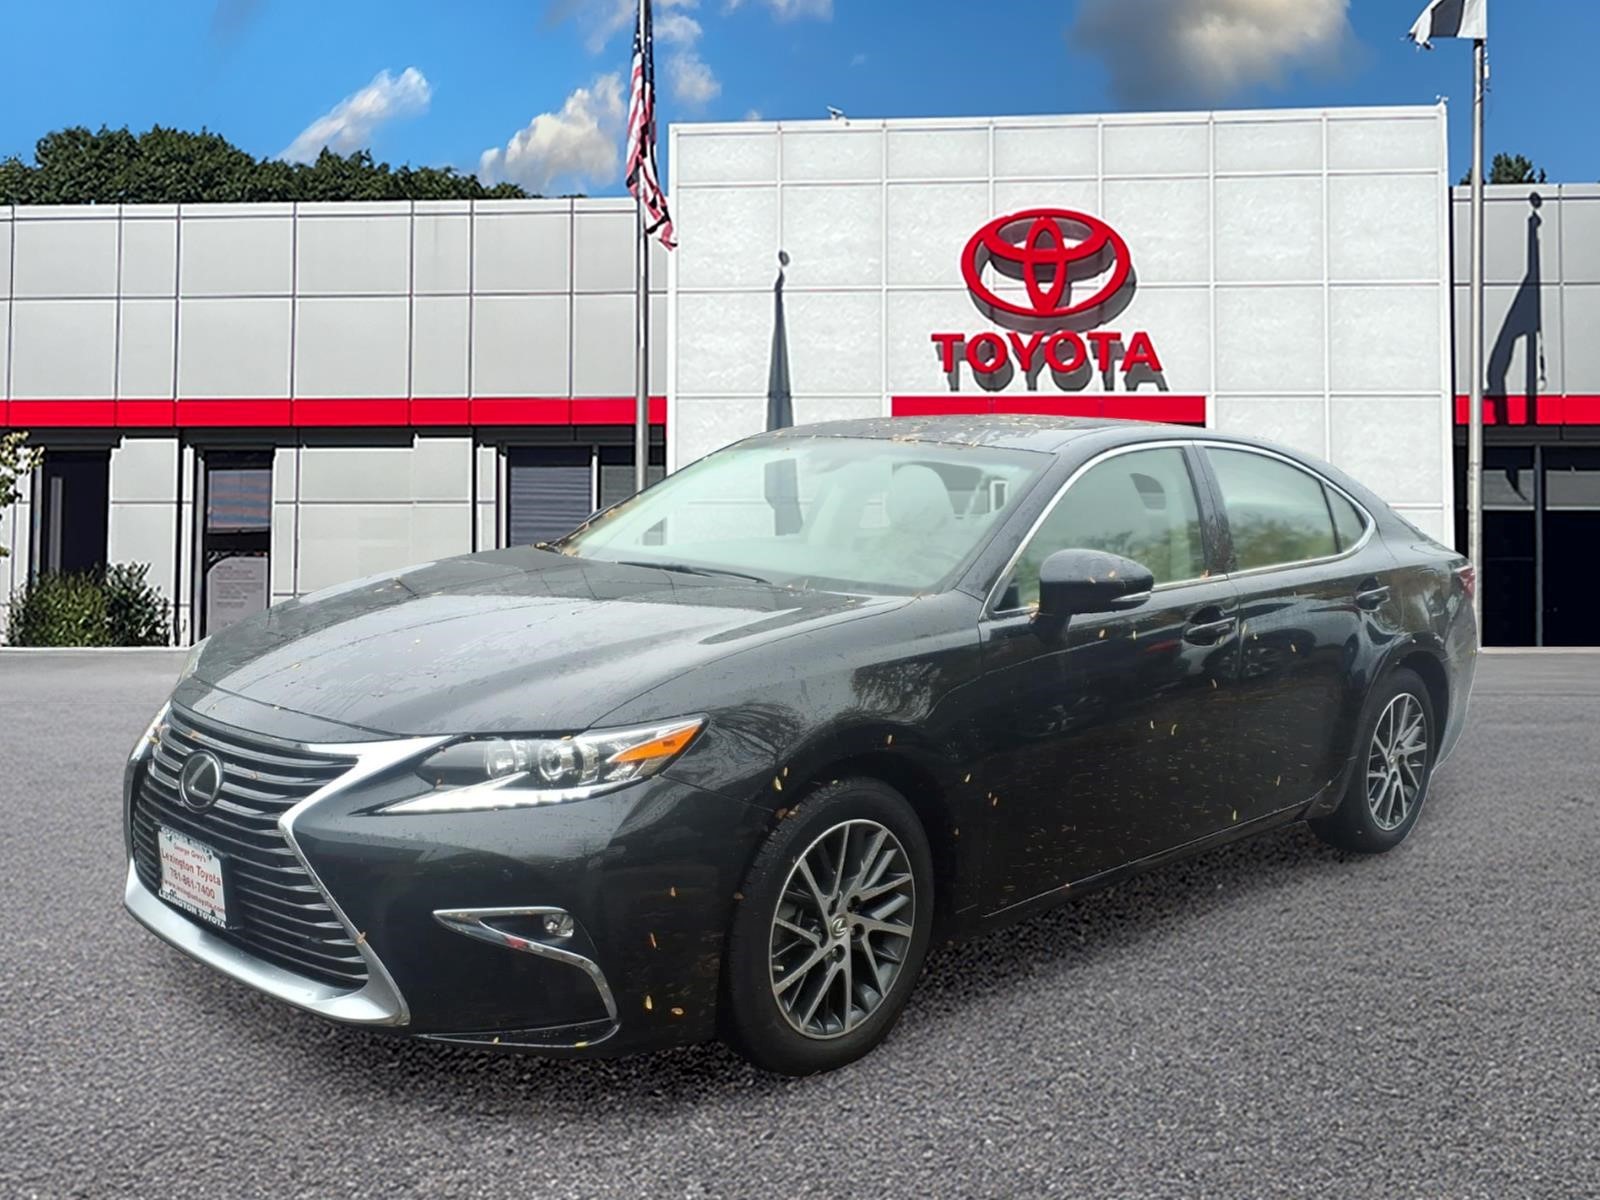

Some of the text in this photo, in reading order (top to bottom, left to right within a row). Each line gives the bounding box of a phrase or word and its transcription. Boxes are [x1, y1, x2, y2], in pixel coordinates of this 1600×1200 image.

[931, 331, 1162, 373] TOYOTA
[161, 848, 221, 886] Lexington Toyota
[198, 909, 226, 929] TOYOTA
